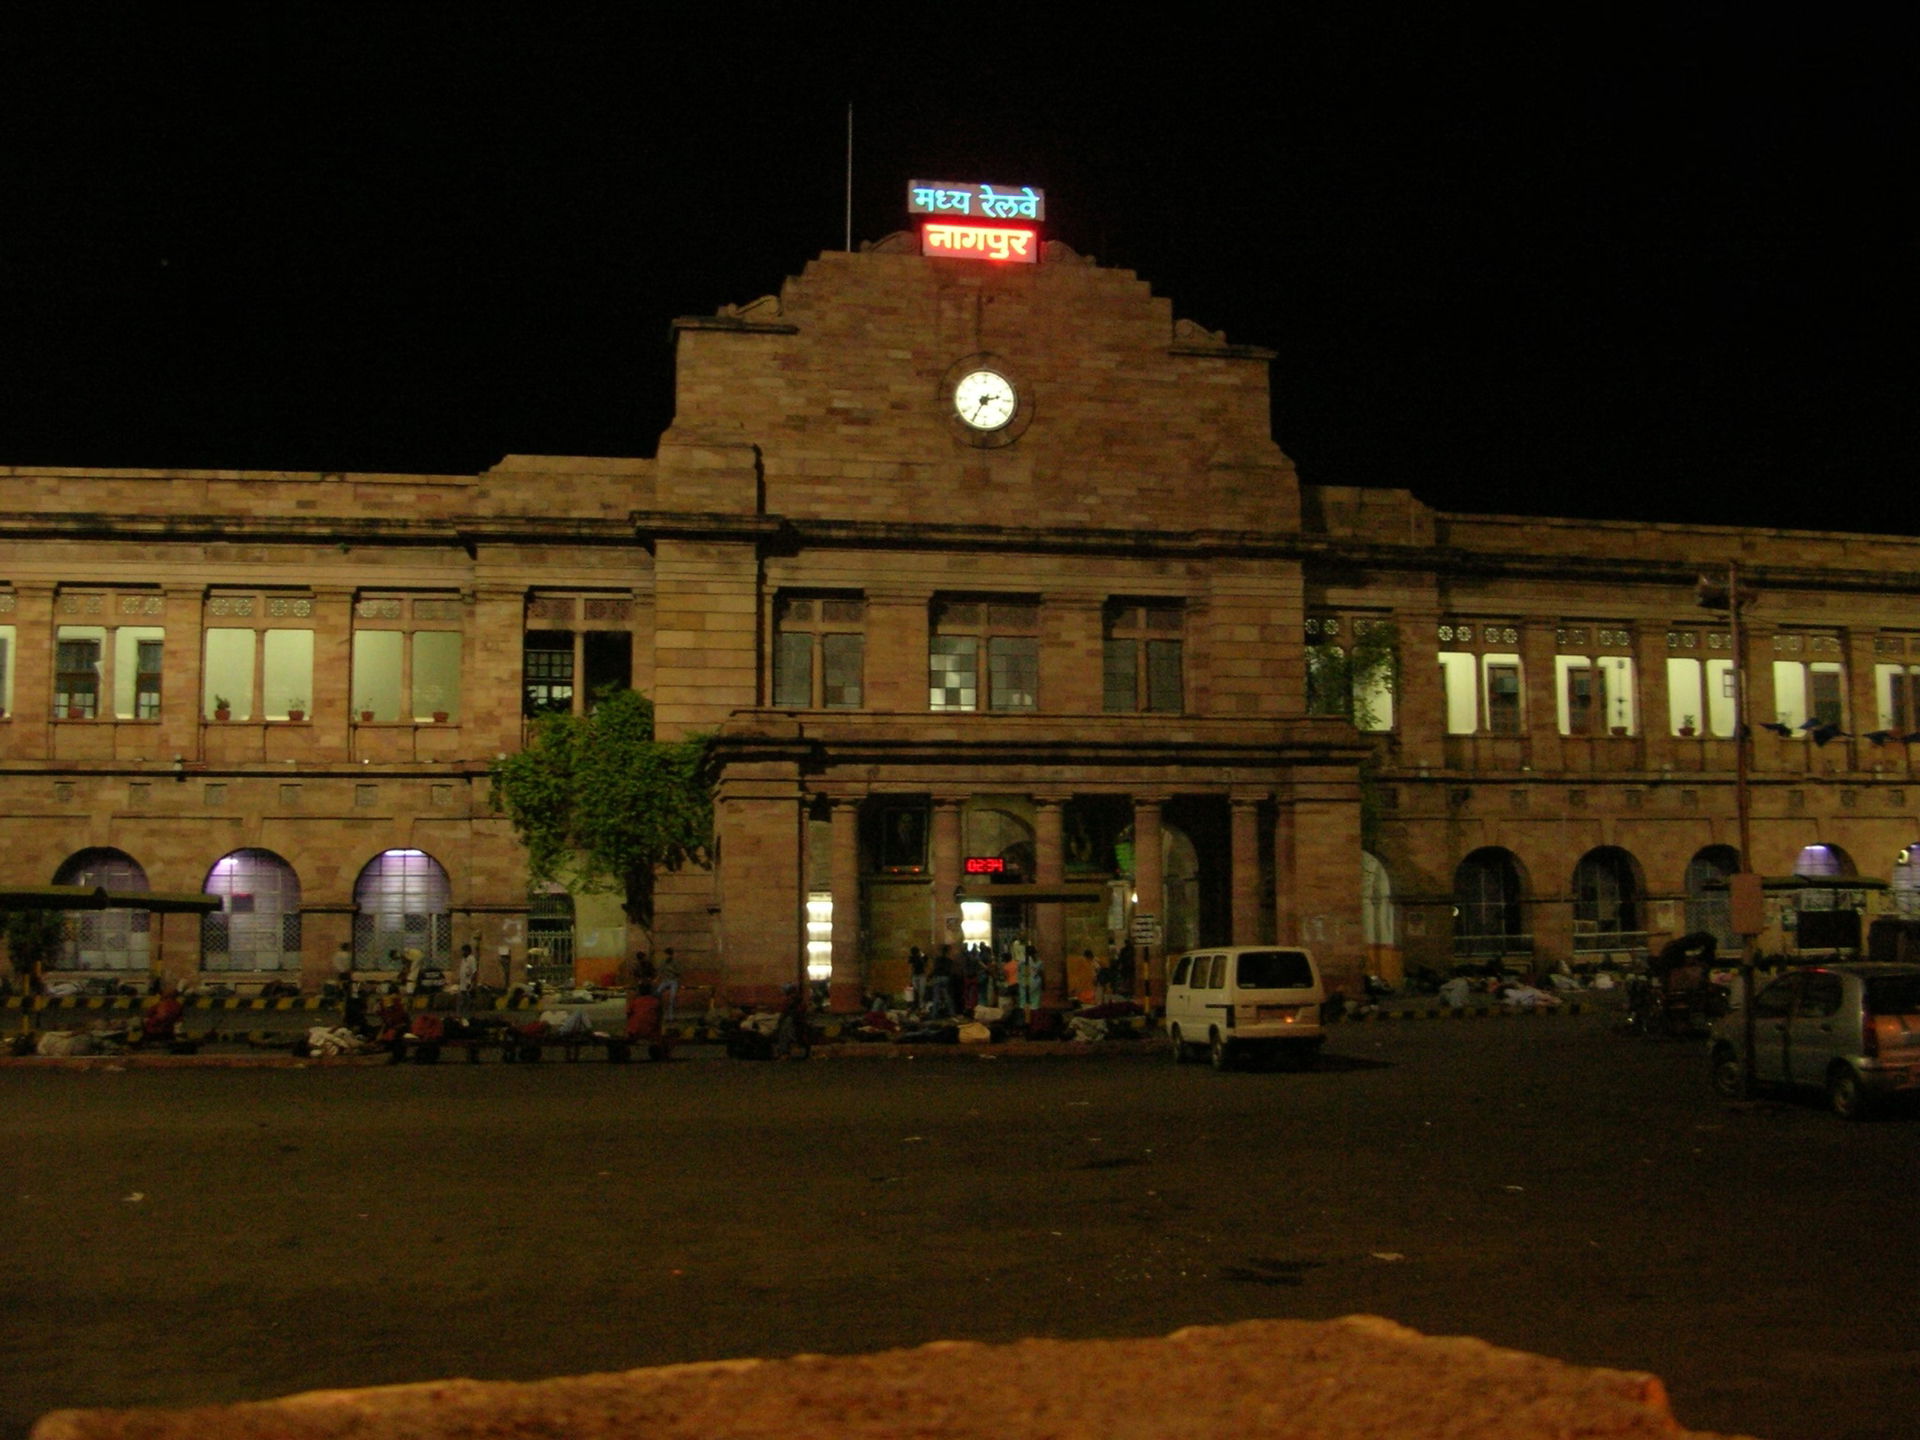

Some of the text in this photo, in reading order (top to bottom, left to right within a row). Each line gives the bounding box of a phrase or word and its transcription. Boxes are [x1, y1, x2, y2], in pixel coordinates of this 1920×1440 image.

[913, 184, 1040, 218] मध्य रेलवे
[926, 224, 1033, 259] नागपुर
